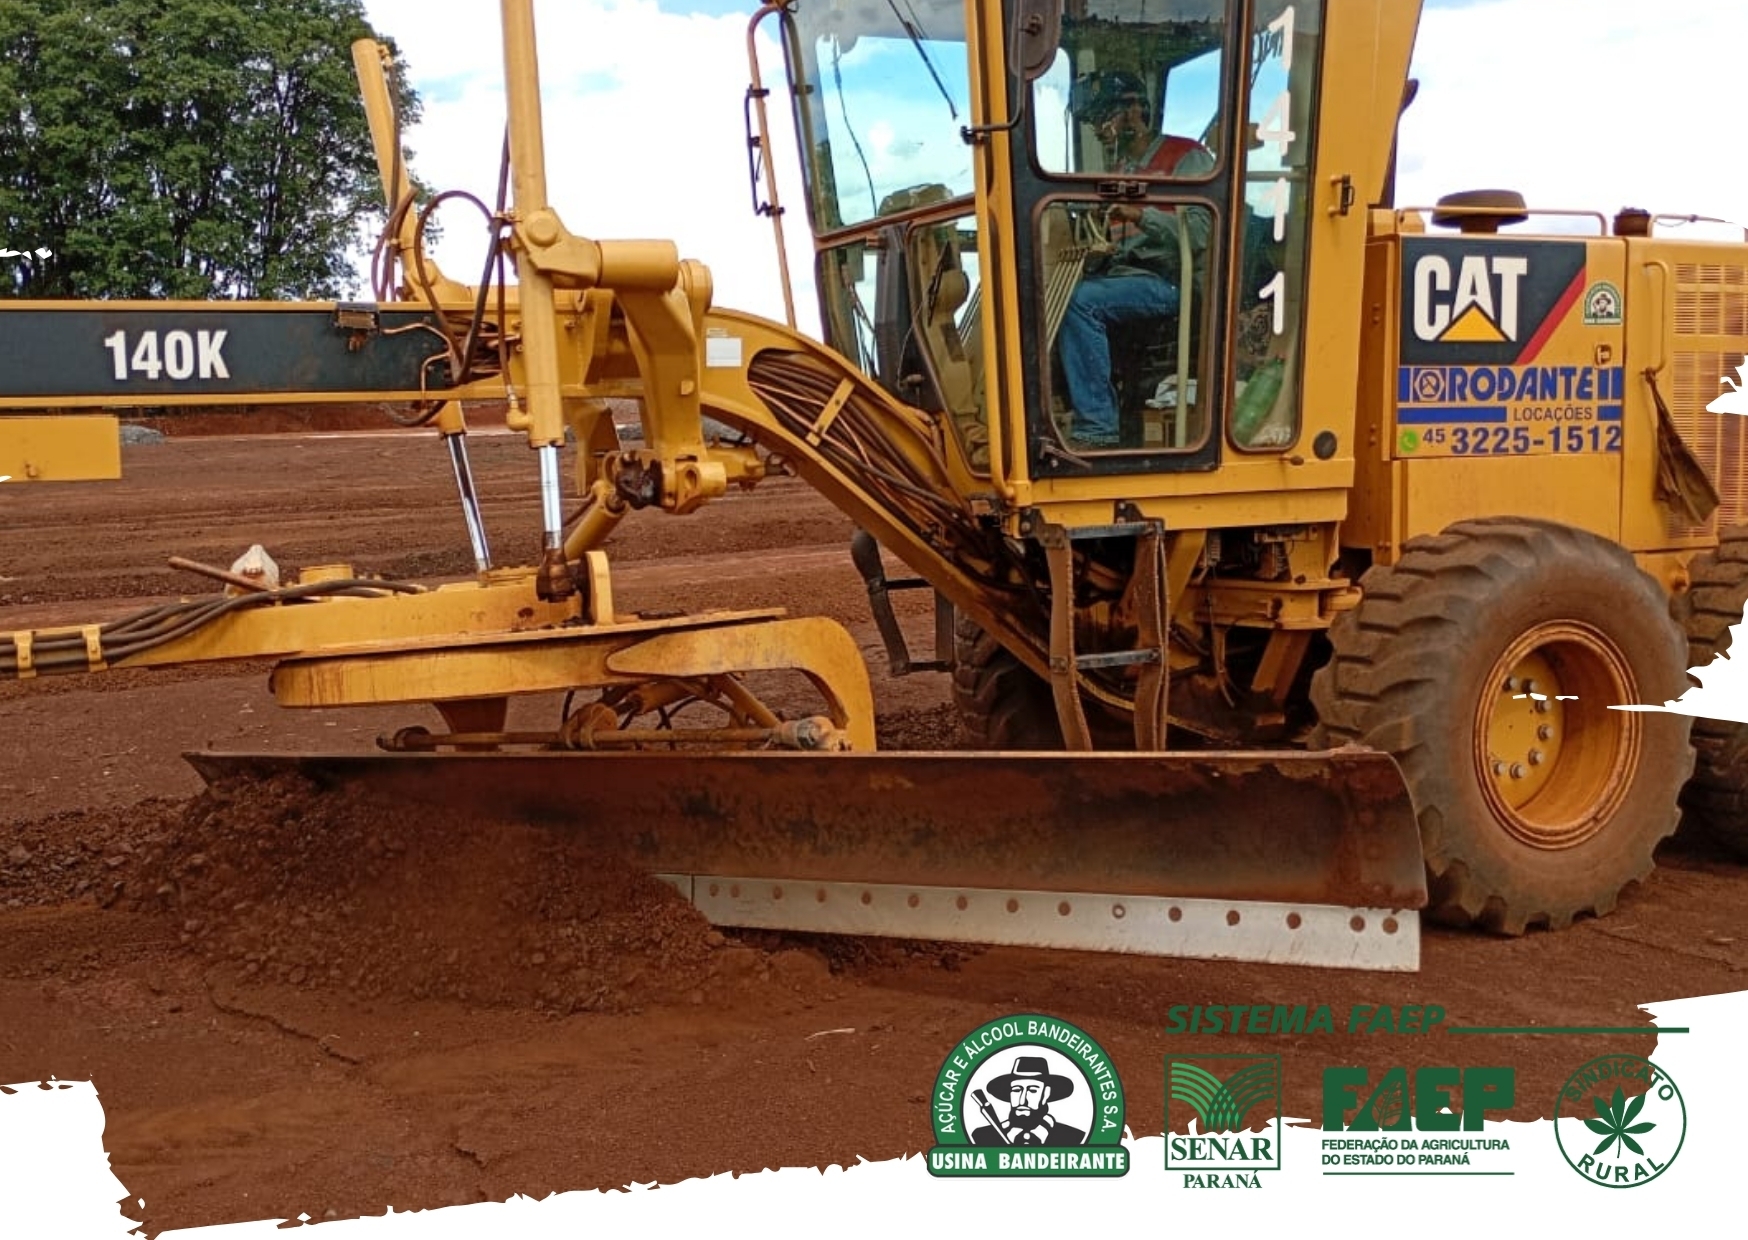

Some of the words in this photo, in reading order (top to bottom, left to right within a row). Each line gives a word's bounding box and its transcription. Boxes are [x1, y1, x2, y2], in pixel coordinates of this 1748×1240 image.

[1413, 254, 1528, 342] CAT
[104, 329, 231, 381] 140K
[1450, 367, 1593, 402] RODANTE
[1513, 404, 1593, 423] LOCAÇÕES
[1422, 428, 1446, 444] 45
[1451, 426, 1622, 454] 3225-1512
